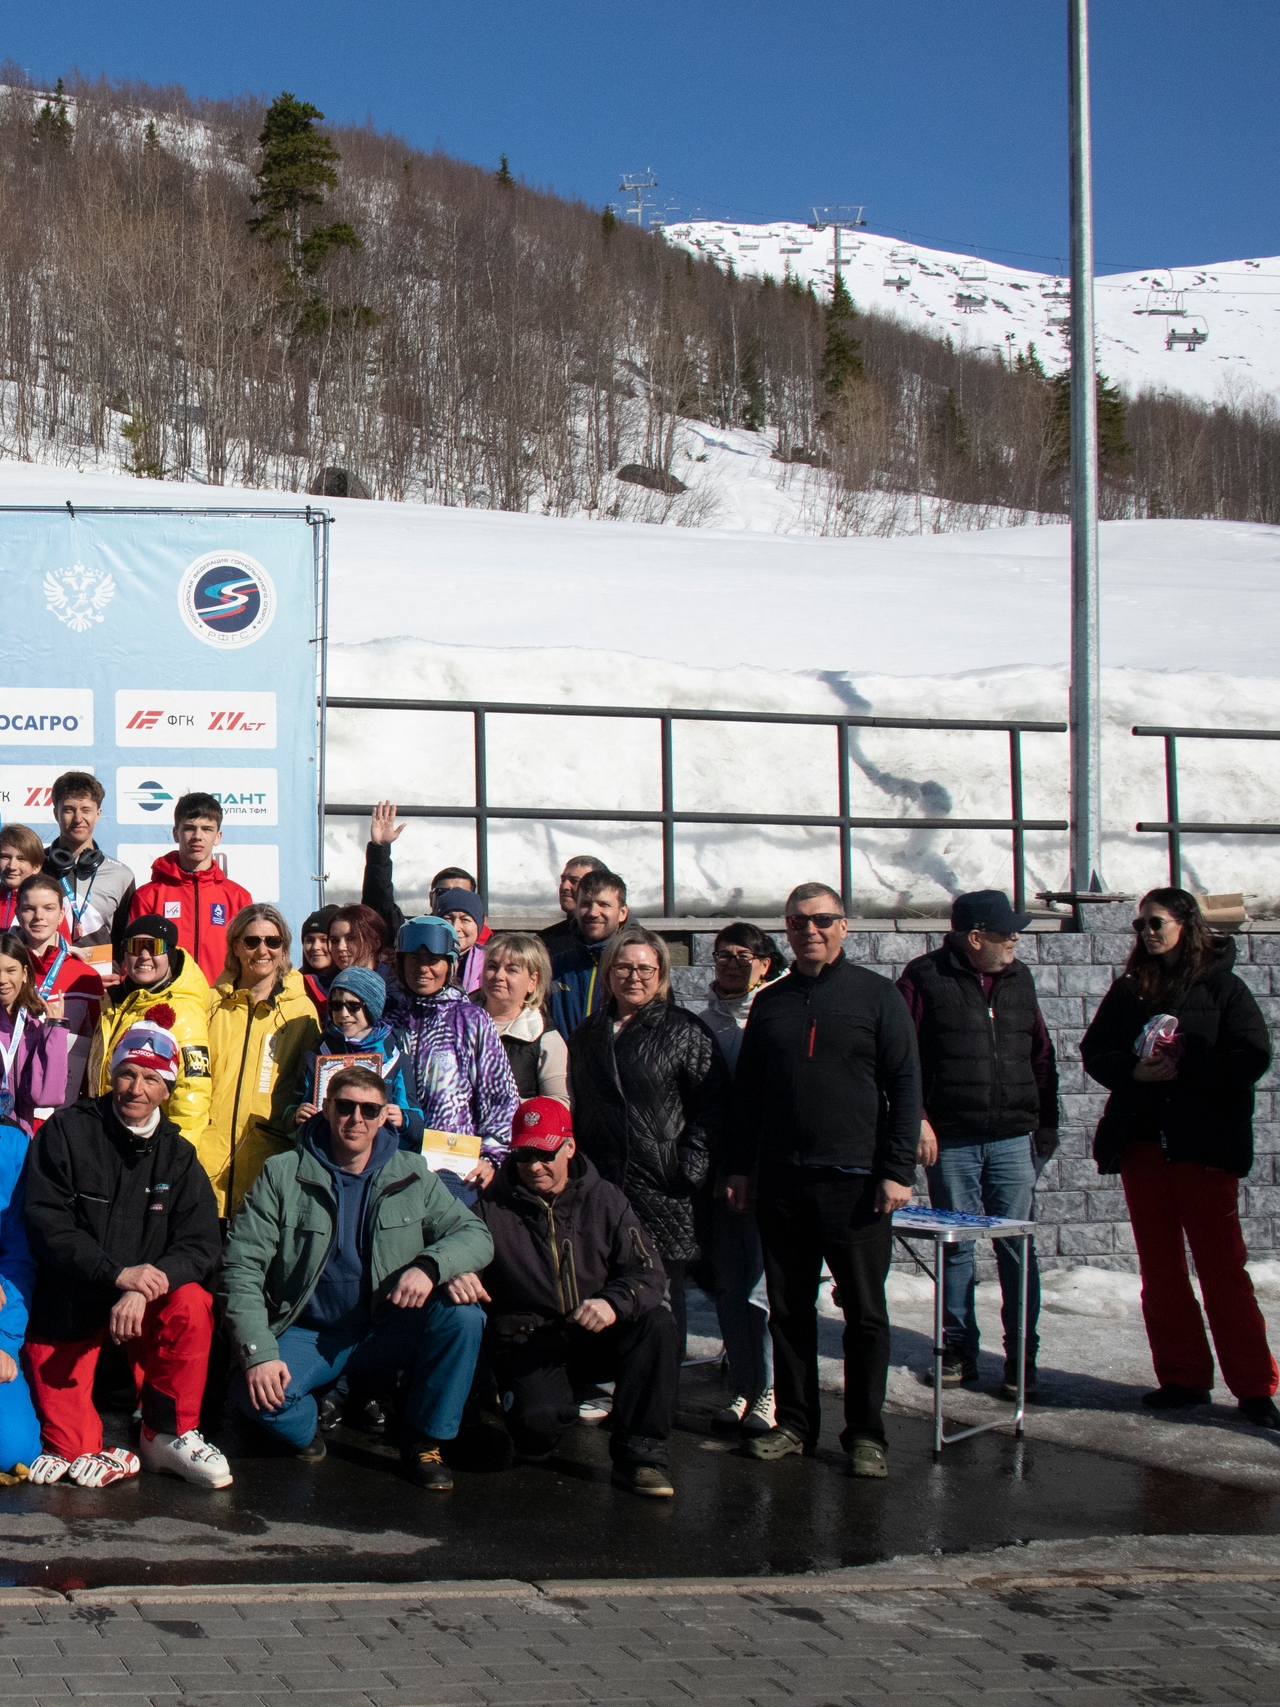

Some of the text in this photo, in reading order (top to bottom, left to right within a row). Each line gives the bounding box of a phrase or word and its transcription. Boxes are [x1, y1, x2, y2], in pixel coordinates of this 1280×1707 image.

[186, 558, 269, 625] РОССИЙСКАЯ ФЕДЕРАЦИЯ ГОРНОЛЫЖНОГО СПОРТА
[207, 630, 249, 641] РФГС
[167, 714, 194, 726] ФГК
